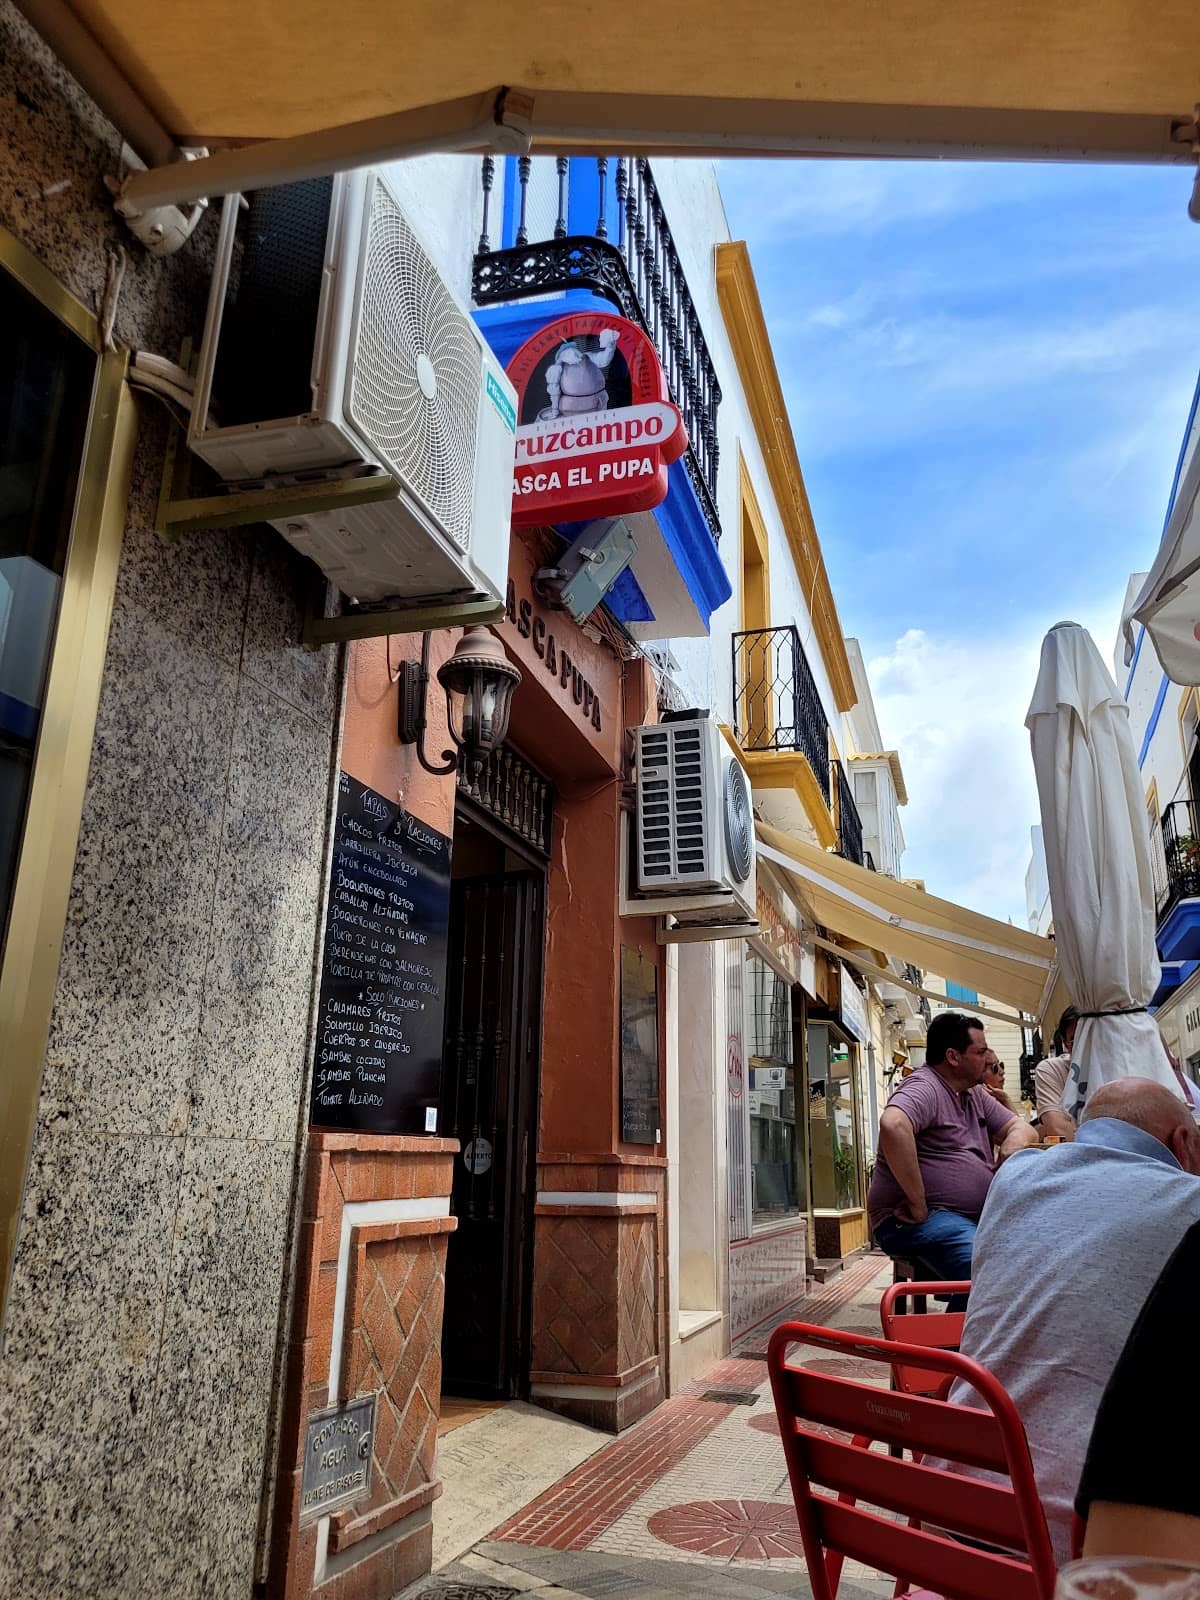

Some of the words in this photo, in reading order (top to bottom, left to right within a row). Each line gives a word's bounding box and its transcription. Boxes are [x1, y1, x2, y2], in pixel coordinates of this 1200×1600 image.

[514, 414, 663, 459] ruzcampo
[512, 472, 562, 496] ASCA
[568, 466, 592, 487] EL
[600, 458, 654, 482] PUPA
[506, 577, 557, 676] ASCA
[560, 649, 602, 732] PUPA
[360, 789, 388, 819] TAPAS
[406, 816, 442, 850] RACIONES
[342, 813, 372, 838] CHOCOS
[377, 832, 402, 854] FRITOS
[340, 834, 380, 860] CARRILLERA
[363, 864, 408, 888] ENCEBOLLADO
[334, 888, 368, 911] CABALLAS
[337, 869, 386, 900] BOQUERONES
[388, 892, 414, 912] FRITOS
[332, 904, 382, 932] BOQUERONES
[398, 928, 428, 945] VINAGRE
[330, 942, 376, 964] BERENJENAS
[356, 934, 366, 946] DE
[371, 940, 378, 949] LA
[381, 942, 396, 955] CASA
[328, 960, 362, 980] TORTILLA
[366, 986, 384, 1002] SOLO
[387, 992, 420, 1009] RACIONES
[325, 1015, 364, 1032] SOLOMILLO
[328, 998, 372, 1017] CALAMARES
[376, 1006, 402, 1026] FRITOS
[324, 1030, 356, 1046] CUERPOS
[360, 1038, 370, 1048] DE
[374, 1040, 410, 1054] CANGREJO
[321, 1048, 352, 1064] GAMBAS
[356, 1056, 386, 1068] COCIDAS
[319, 1069, 351, 1086] GAMBAS
[356, 1066, 386, 1083] PLANCHA
[318, 1087, 342, 1106] TOMATE
[349, 1088, 384, 1106] ALIÑADO
[312, 1417, 359, 1452] CONTADOR
[320, 1445, 348, 1472] AGUA
[325, 1480, 335, 1498] DE
[336, 1473, 354, 1490] PASO
